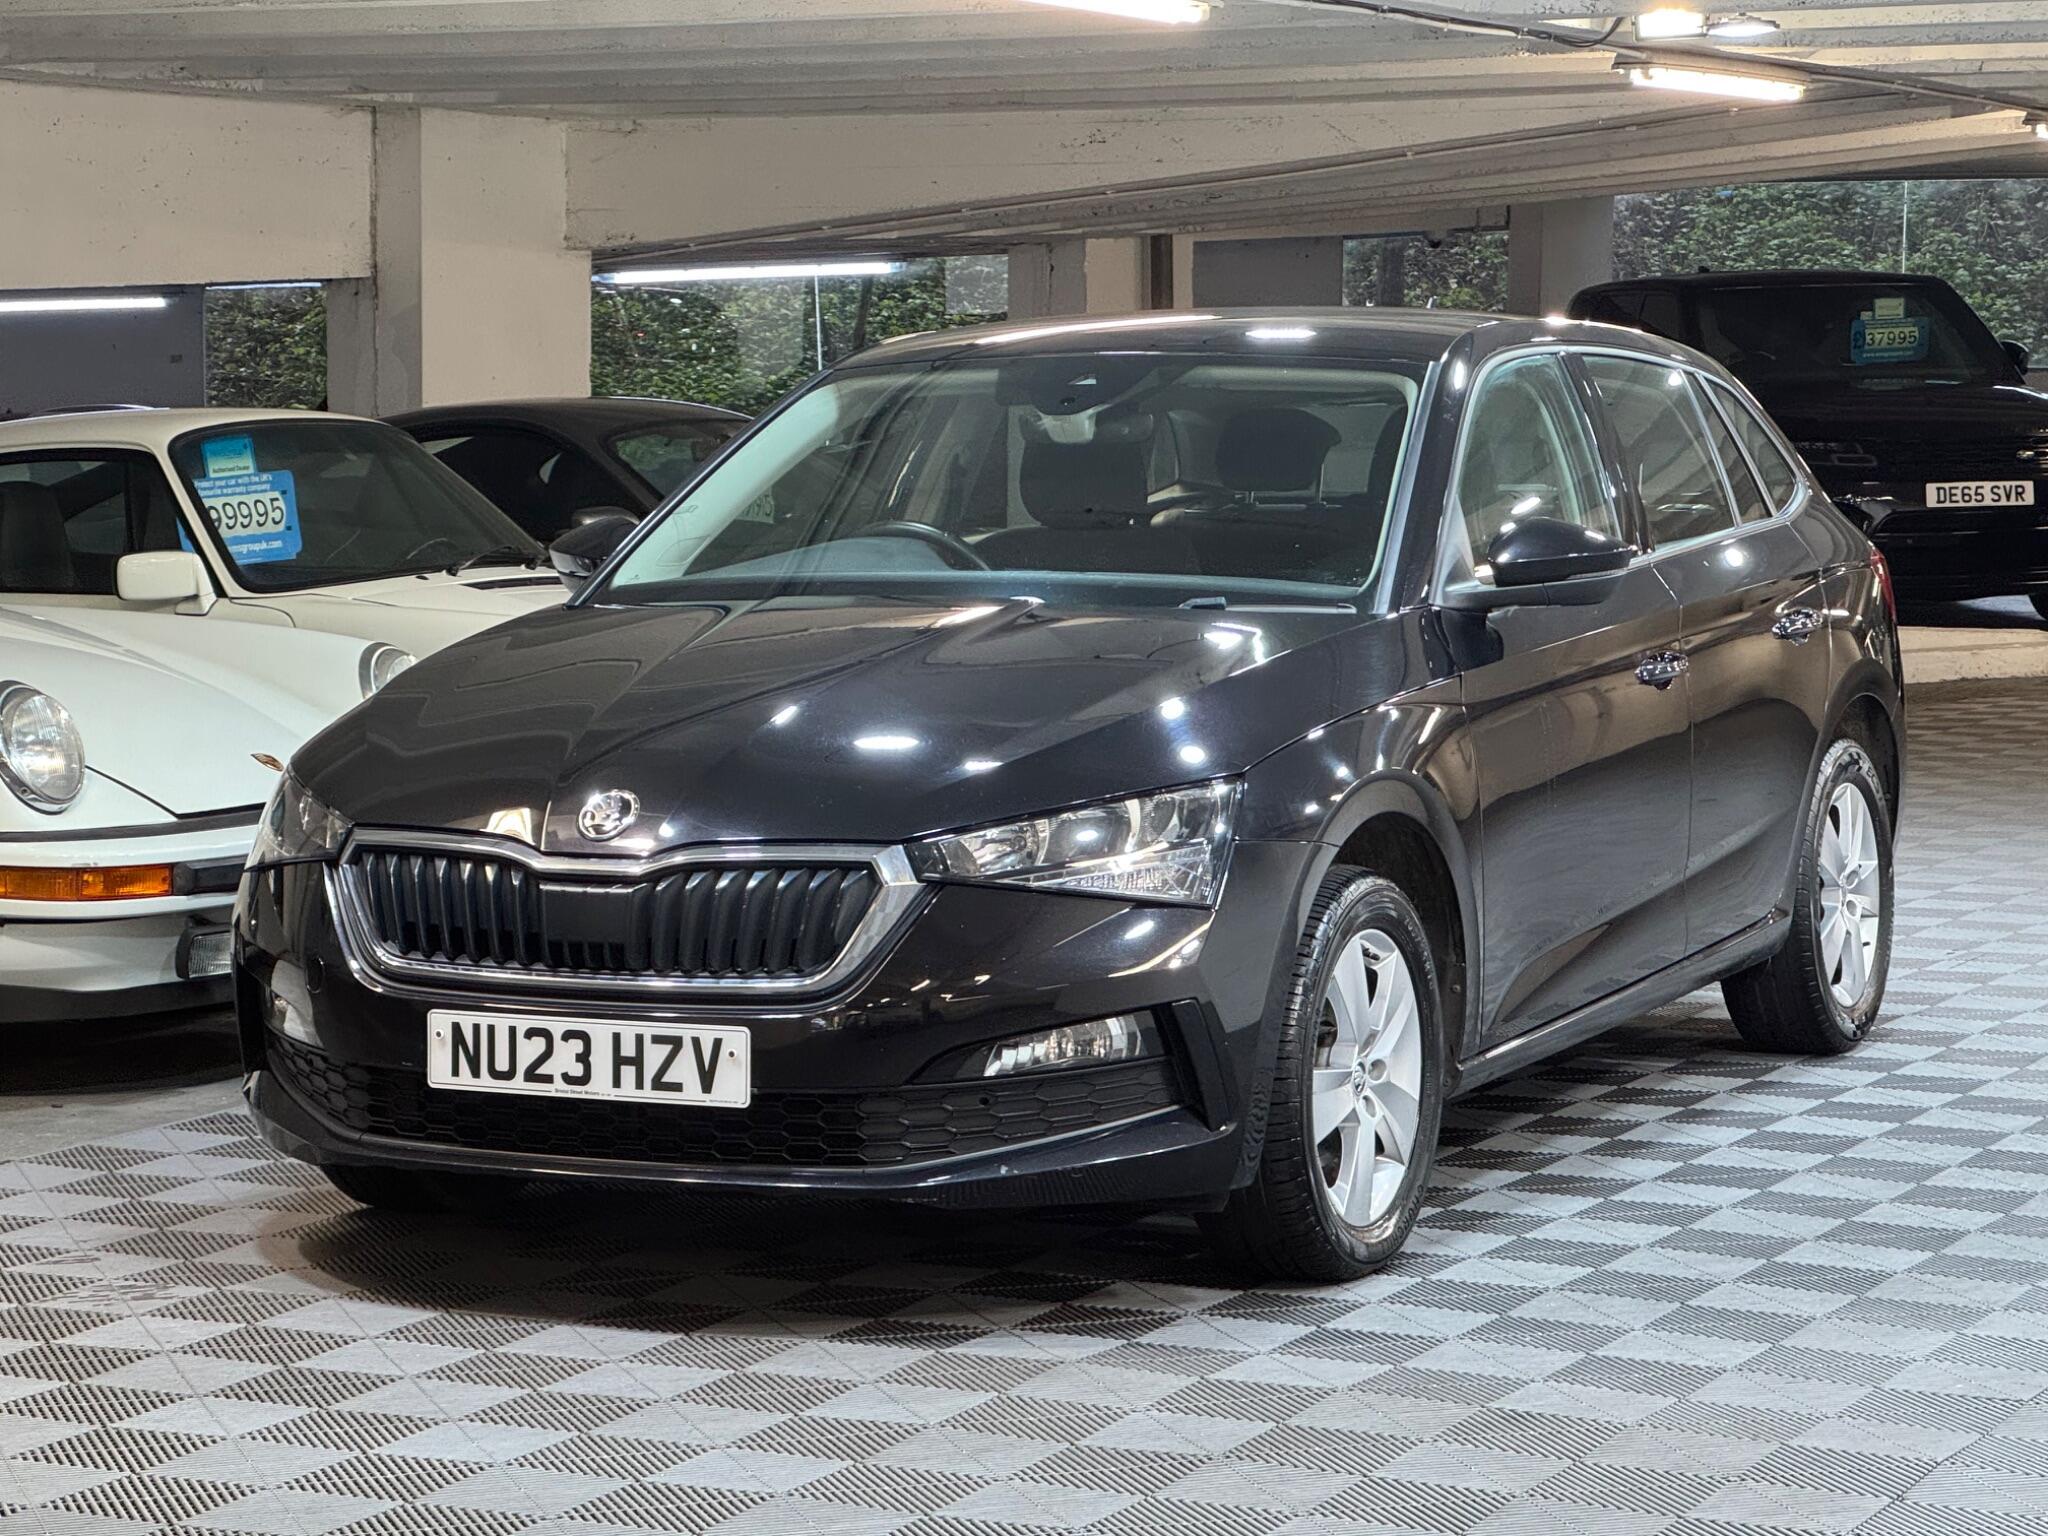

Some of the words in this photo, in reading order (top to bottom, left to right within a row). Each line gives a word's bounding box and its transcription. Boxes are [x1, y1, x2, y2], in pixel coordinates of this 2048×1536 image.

[1935, 486, 1985, 504] DE65
[1990, 484, 2026, 502] SVR
[451, 1021, 592, 1086] NU23
[612, 1031, 723, 1094] HZV
